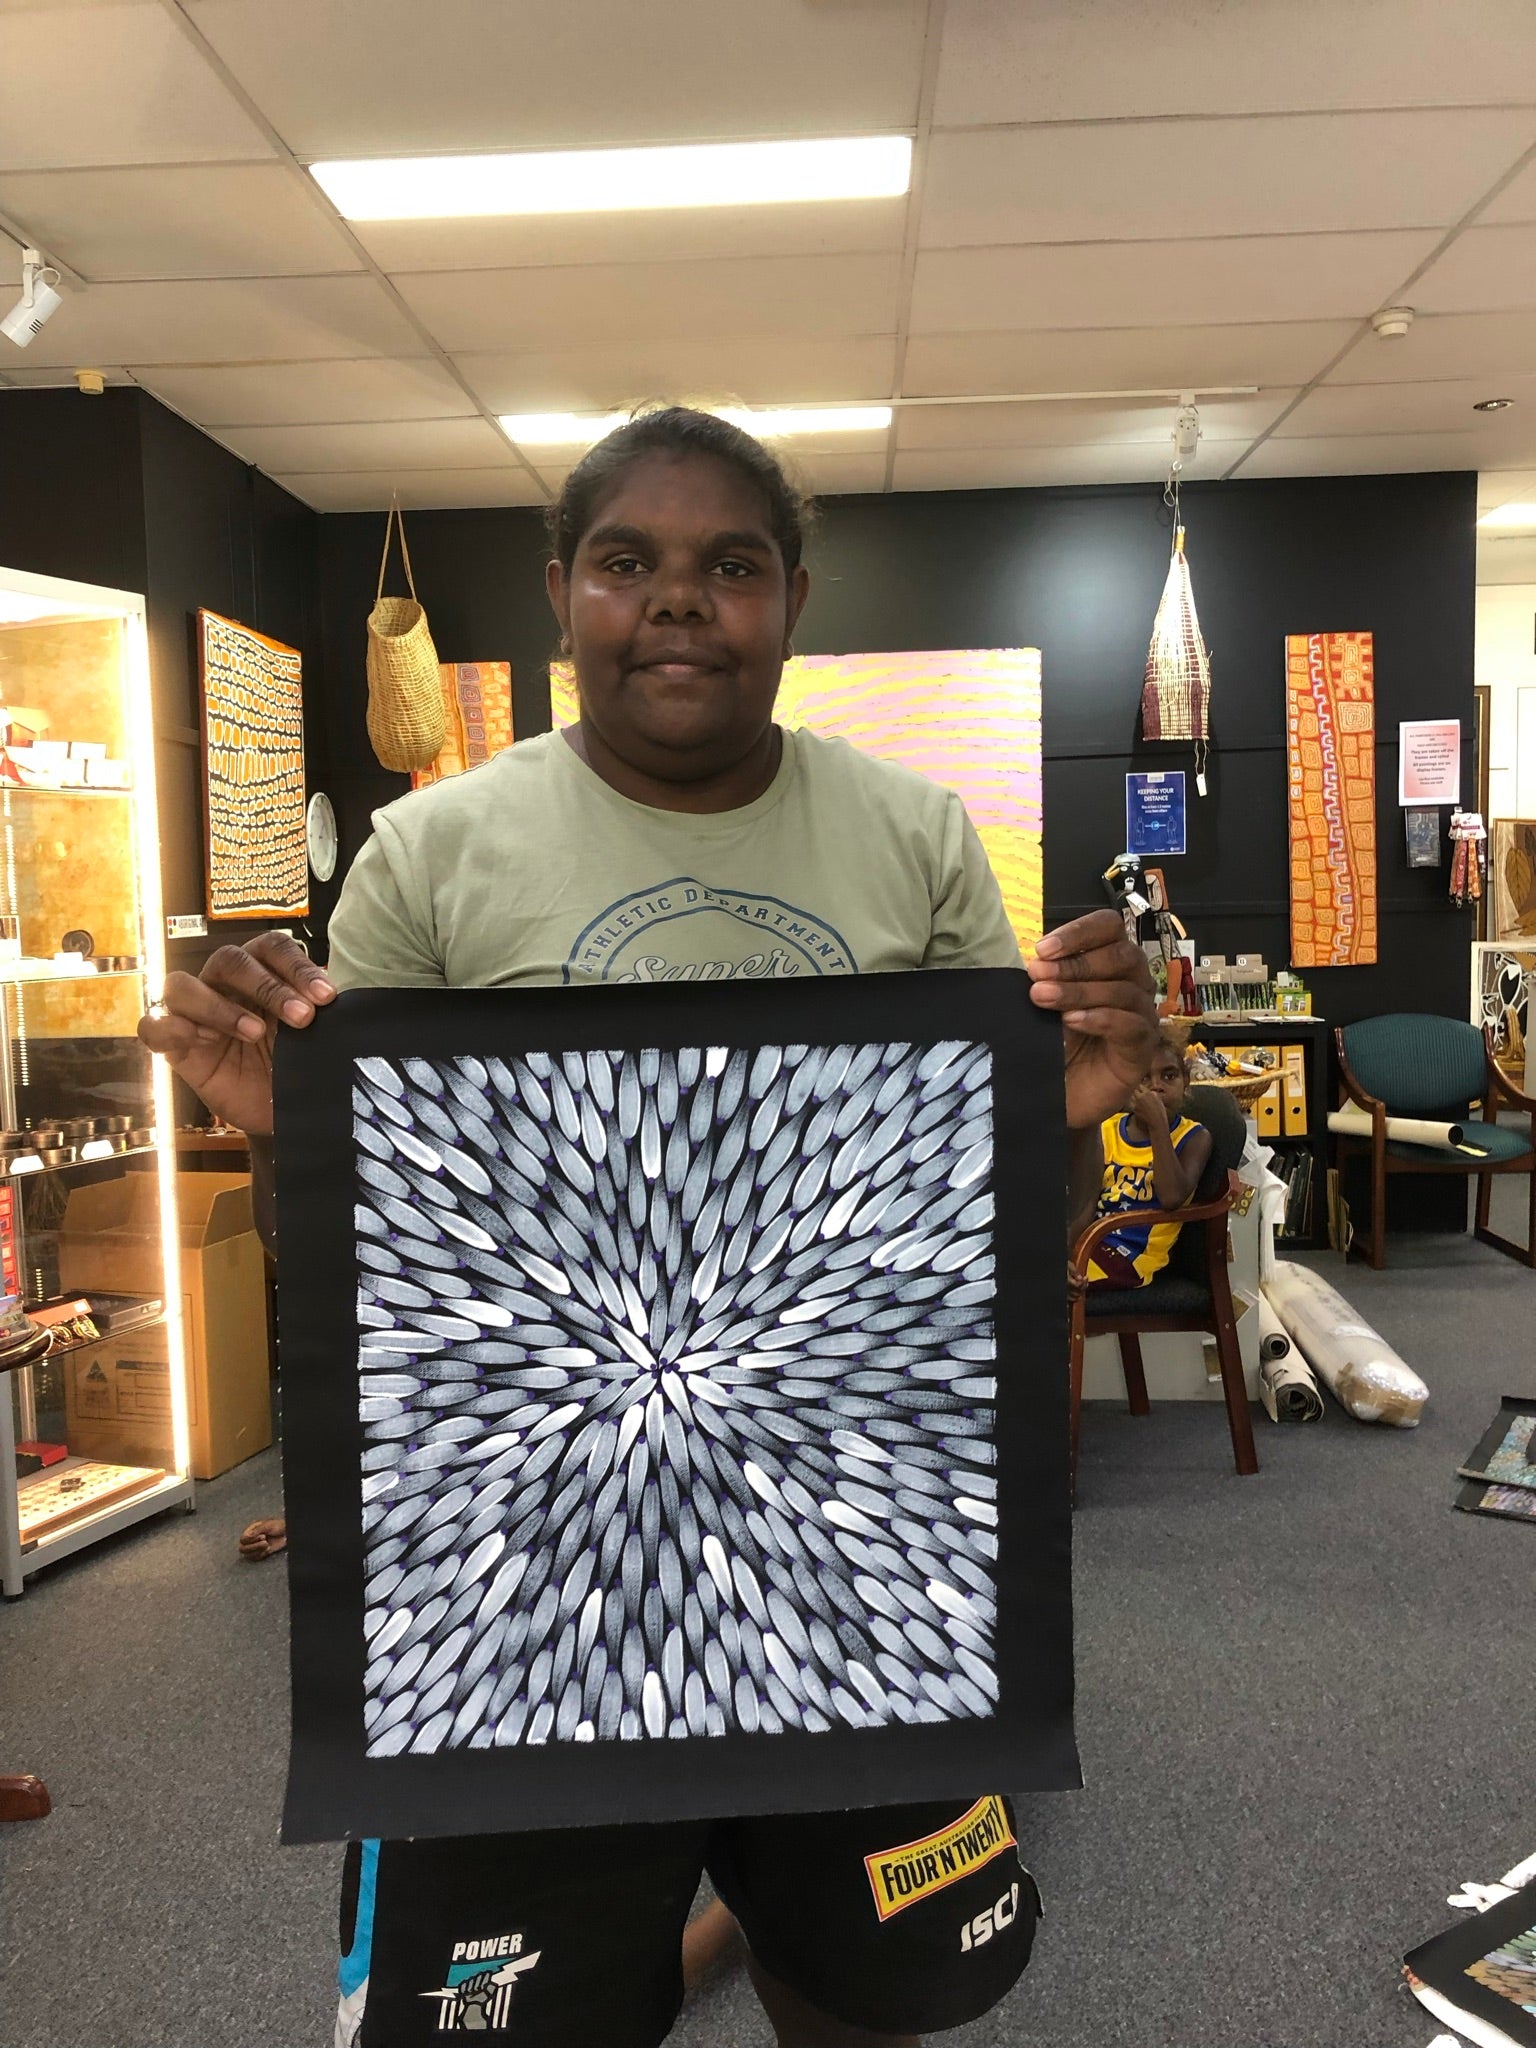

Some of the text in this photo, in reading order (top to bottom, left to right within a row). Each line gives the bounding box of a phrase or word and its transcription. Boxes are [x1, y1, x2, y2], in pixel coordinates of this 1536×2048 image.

[579, 888, 846, 974] ATHLETIC DEPARTMENT
[899, 1853, 914, 1862] THE
[916, 1844, 938, 1856] GREAT
[940, 1821, 974, 1846] AUSTRALIAN
[952, 1795, 1006, 1867] TWENTY
[452, 1933, 523, 1961] POWER
